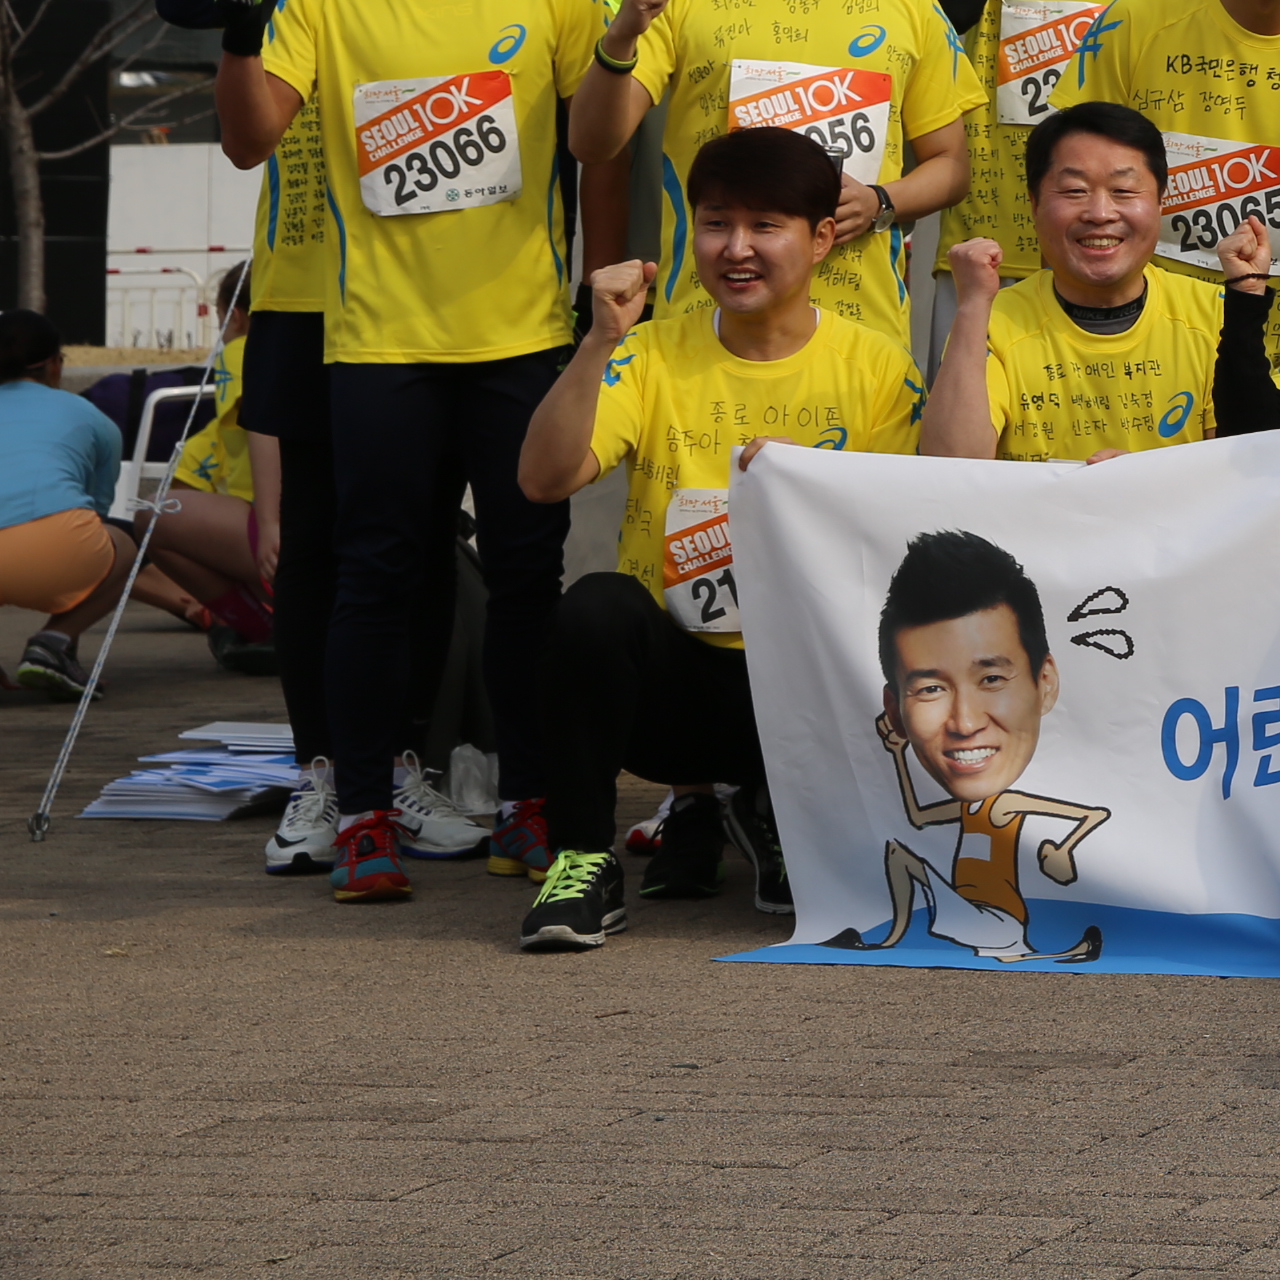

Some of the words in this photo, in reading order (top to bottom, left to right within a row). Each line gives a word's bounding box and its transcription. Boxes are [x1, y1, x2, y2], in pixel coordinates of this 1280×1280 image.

[1004, 28, 1061, 64] SEOUL
[1009, 46, 1065, 73] CHALLENGE
[360, 109, 419, 153] SEOUL
[413, 76, 484, 132] 10K
[734, 91, 799, 126] SEOUL
[796, 71, 863, 116] 10K
[1021, 68, 1061, 117] 23
[368, 128, 425, 162] CHALLENGE
[383, 114, 506, 207] 23066
[1163, 166, 1214, 198] EOUL
[1211, 149, 1278, 193] 10K
[1072, 308, 1105, 320] NIKE
[1109, 302, 1138, 319] PRO
[691, 567, 739, 624] 21
